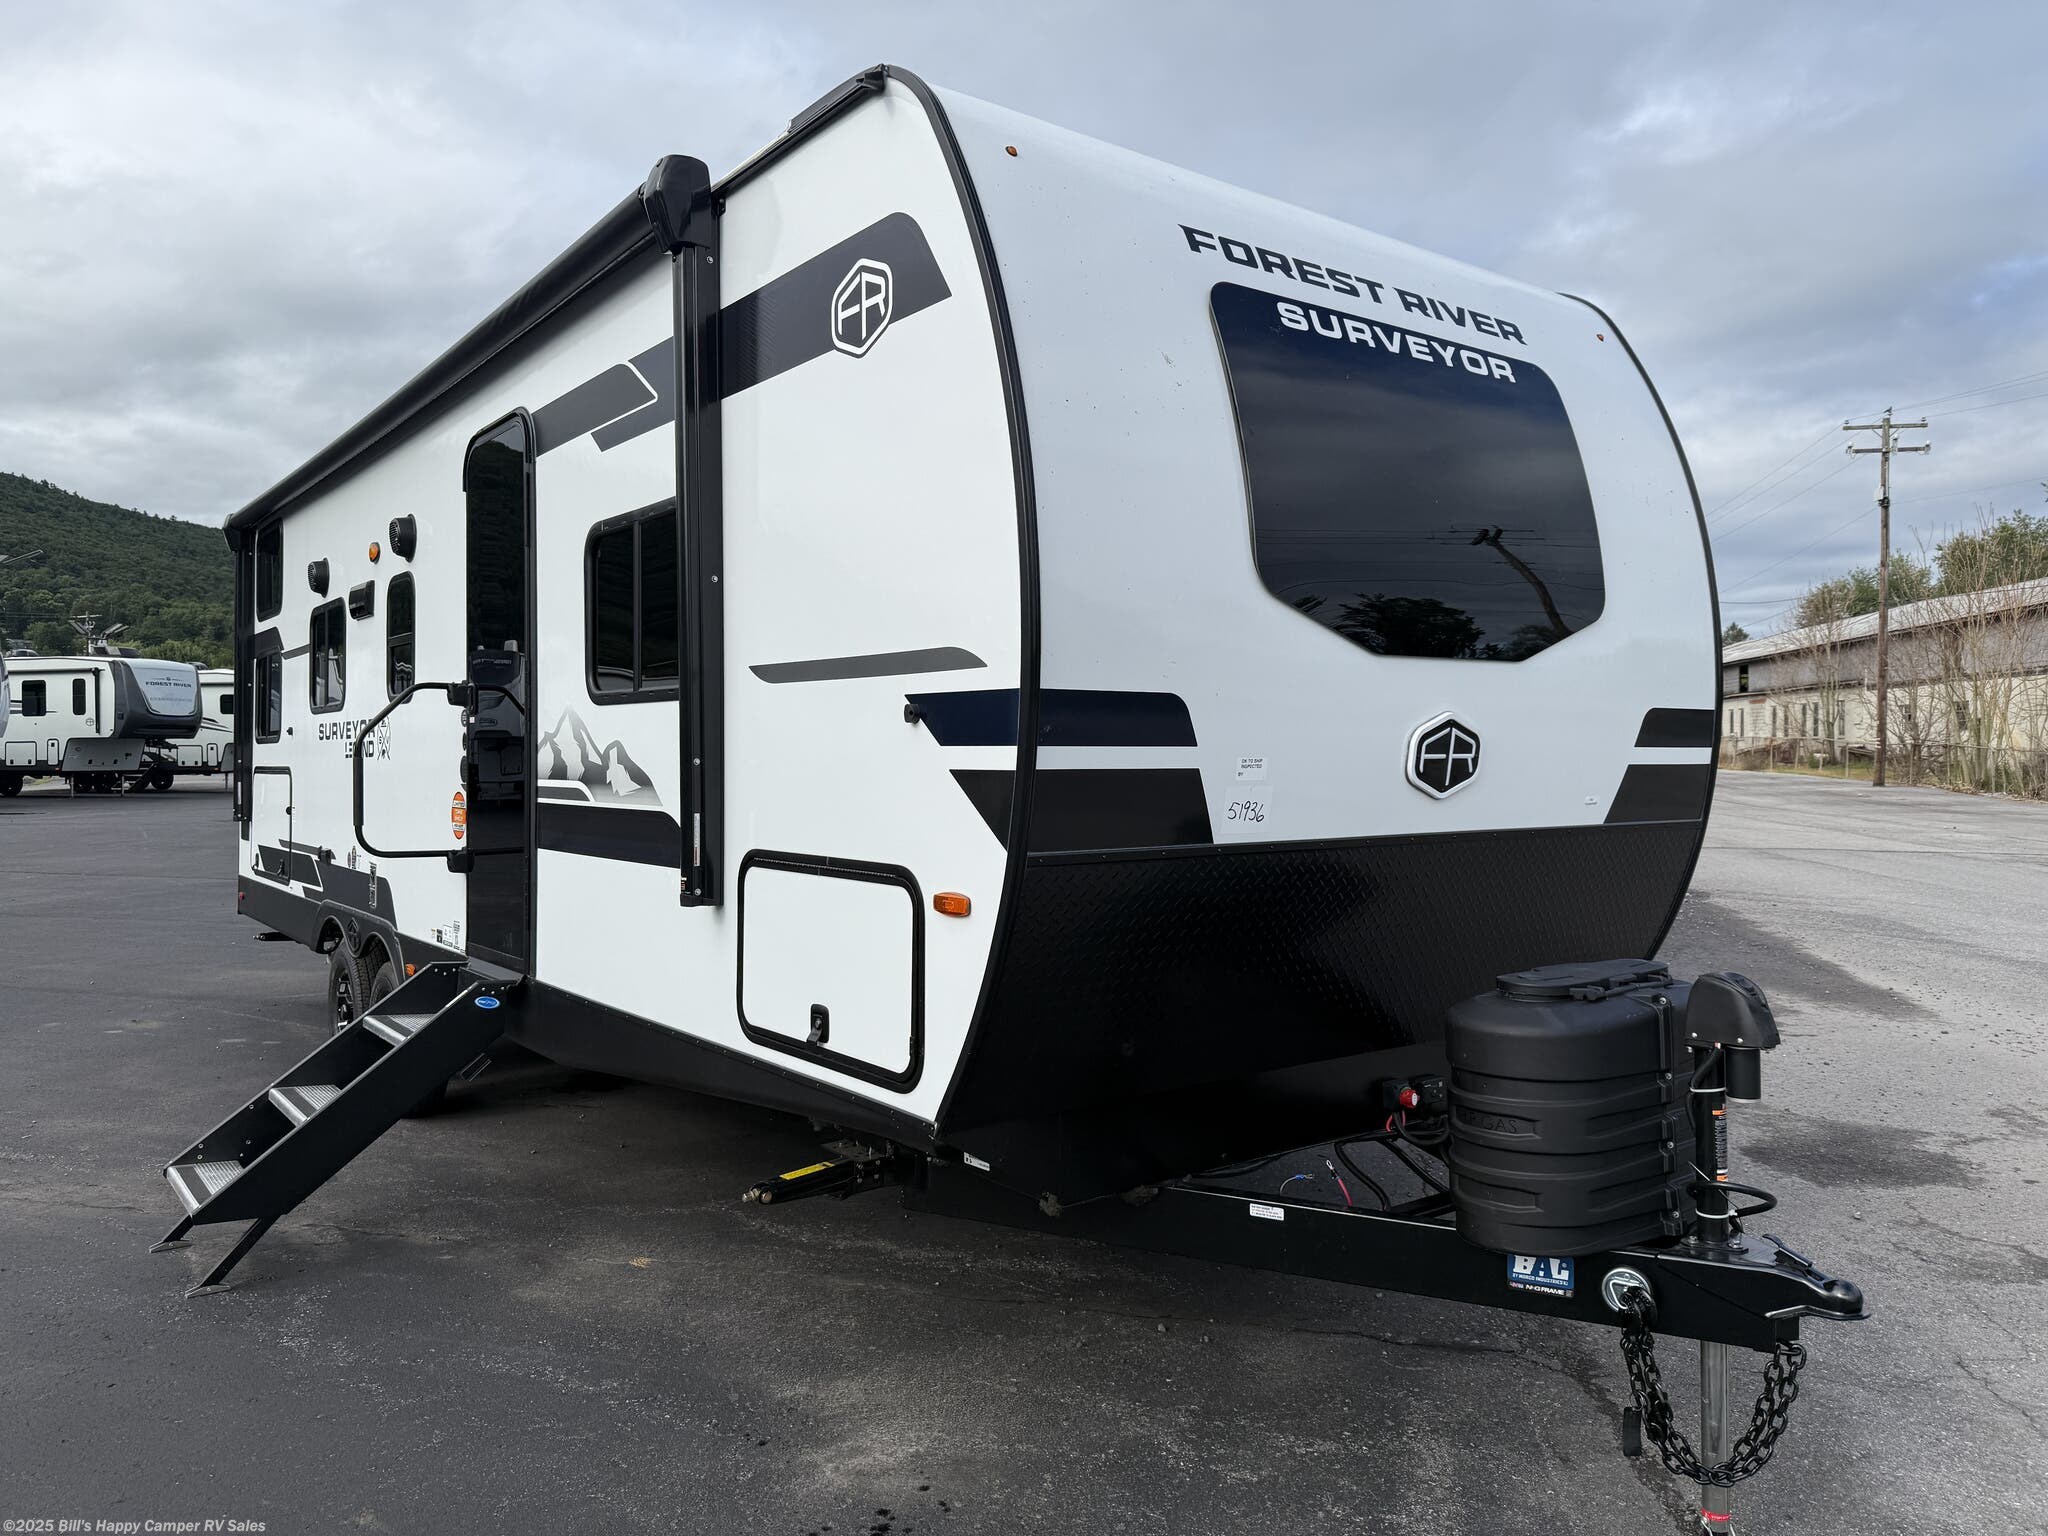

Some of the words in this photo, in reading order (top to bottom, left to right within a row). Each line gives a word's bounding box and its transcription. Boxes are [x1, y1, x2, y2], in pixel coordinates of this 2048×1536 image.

[1178, 223, 1384, 304] FOREST
[1392, 286, 1528, 346] RIVER
[1276, 301, 1517, 384] SURVEYOR
[345, 740, 375, 759] LEND
[1227, 800, 1265, 823] 51936
[1481, 1115, 1518, 1134] GAS
[1513, 1254, 1570, 1281] BAL
